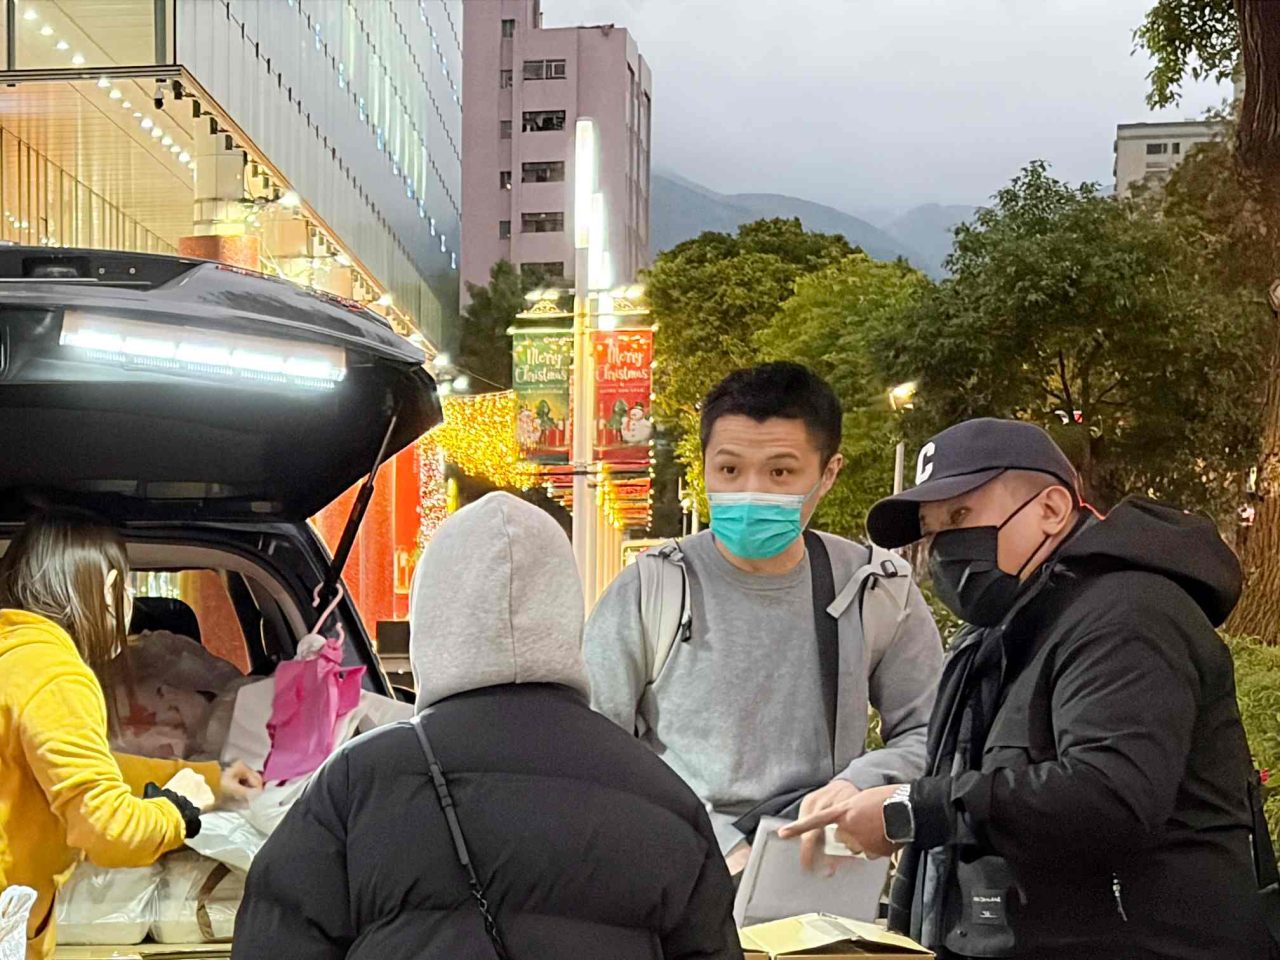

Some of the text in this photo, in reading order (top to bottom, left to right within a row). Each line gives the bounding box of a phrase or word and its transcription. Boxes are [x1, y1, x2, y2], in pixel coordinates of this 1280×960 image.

[526, 345, 563, 368] Merry
[608, 339, 644, 367] Merry
[514, 364, 568, 383] Christmas
[595, 362, 649, 382] Christmas
[915, 441, 936, 486] C
